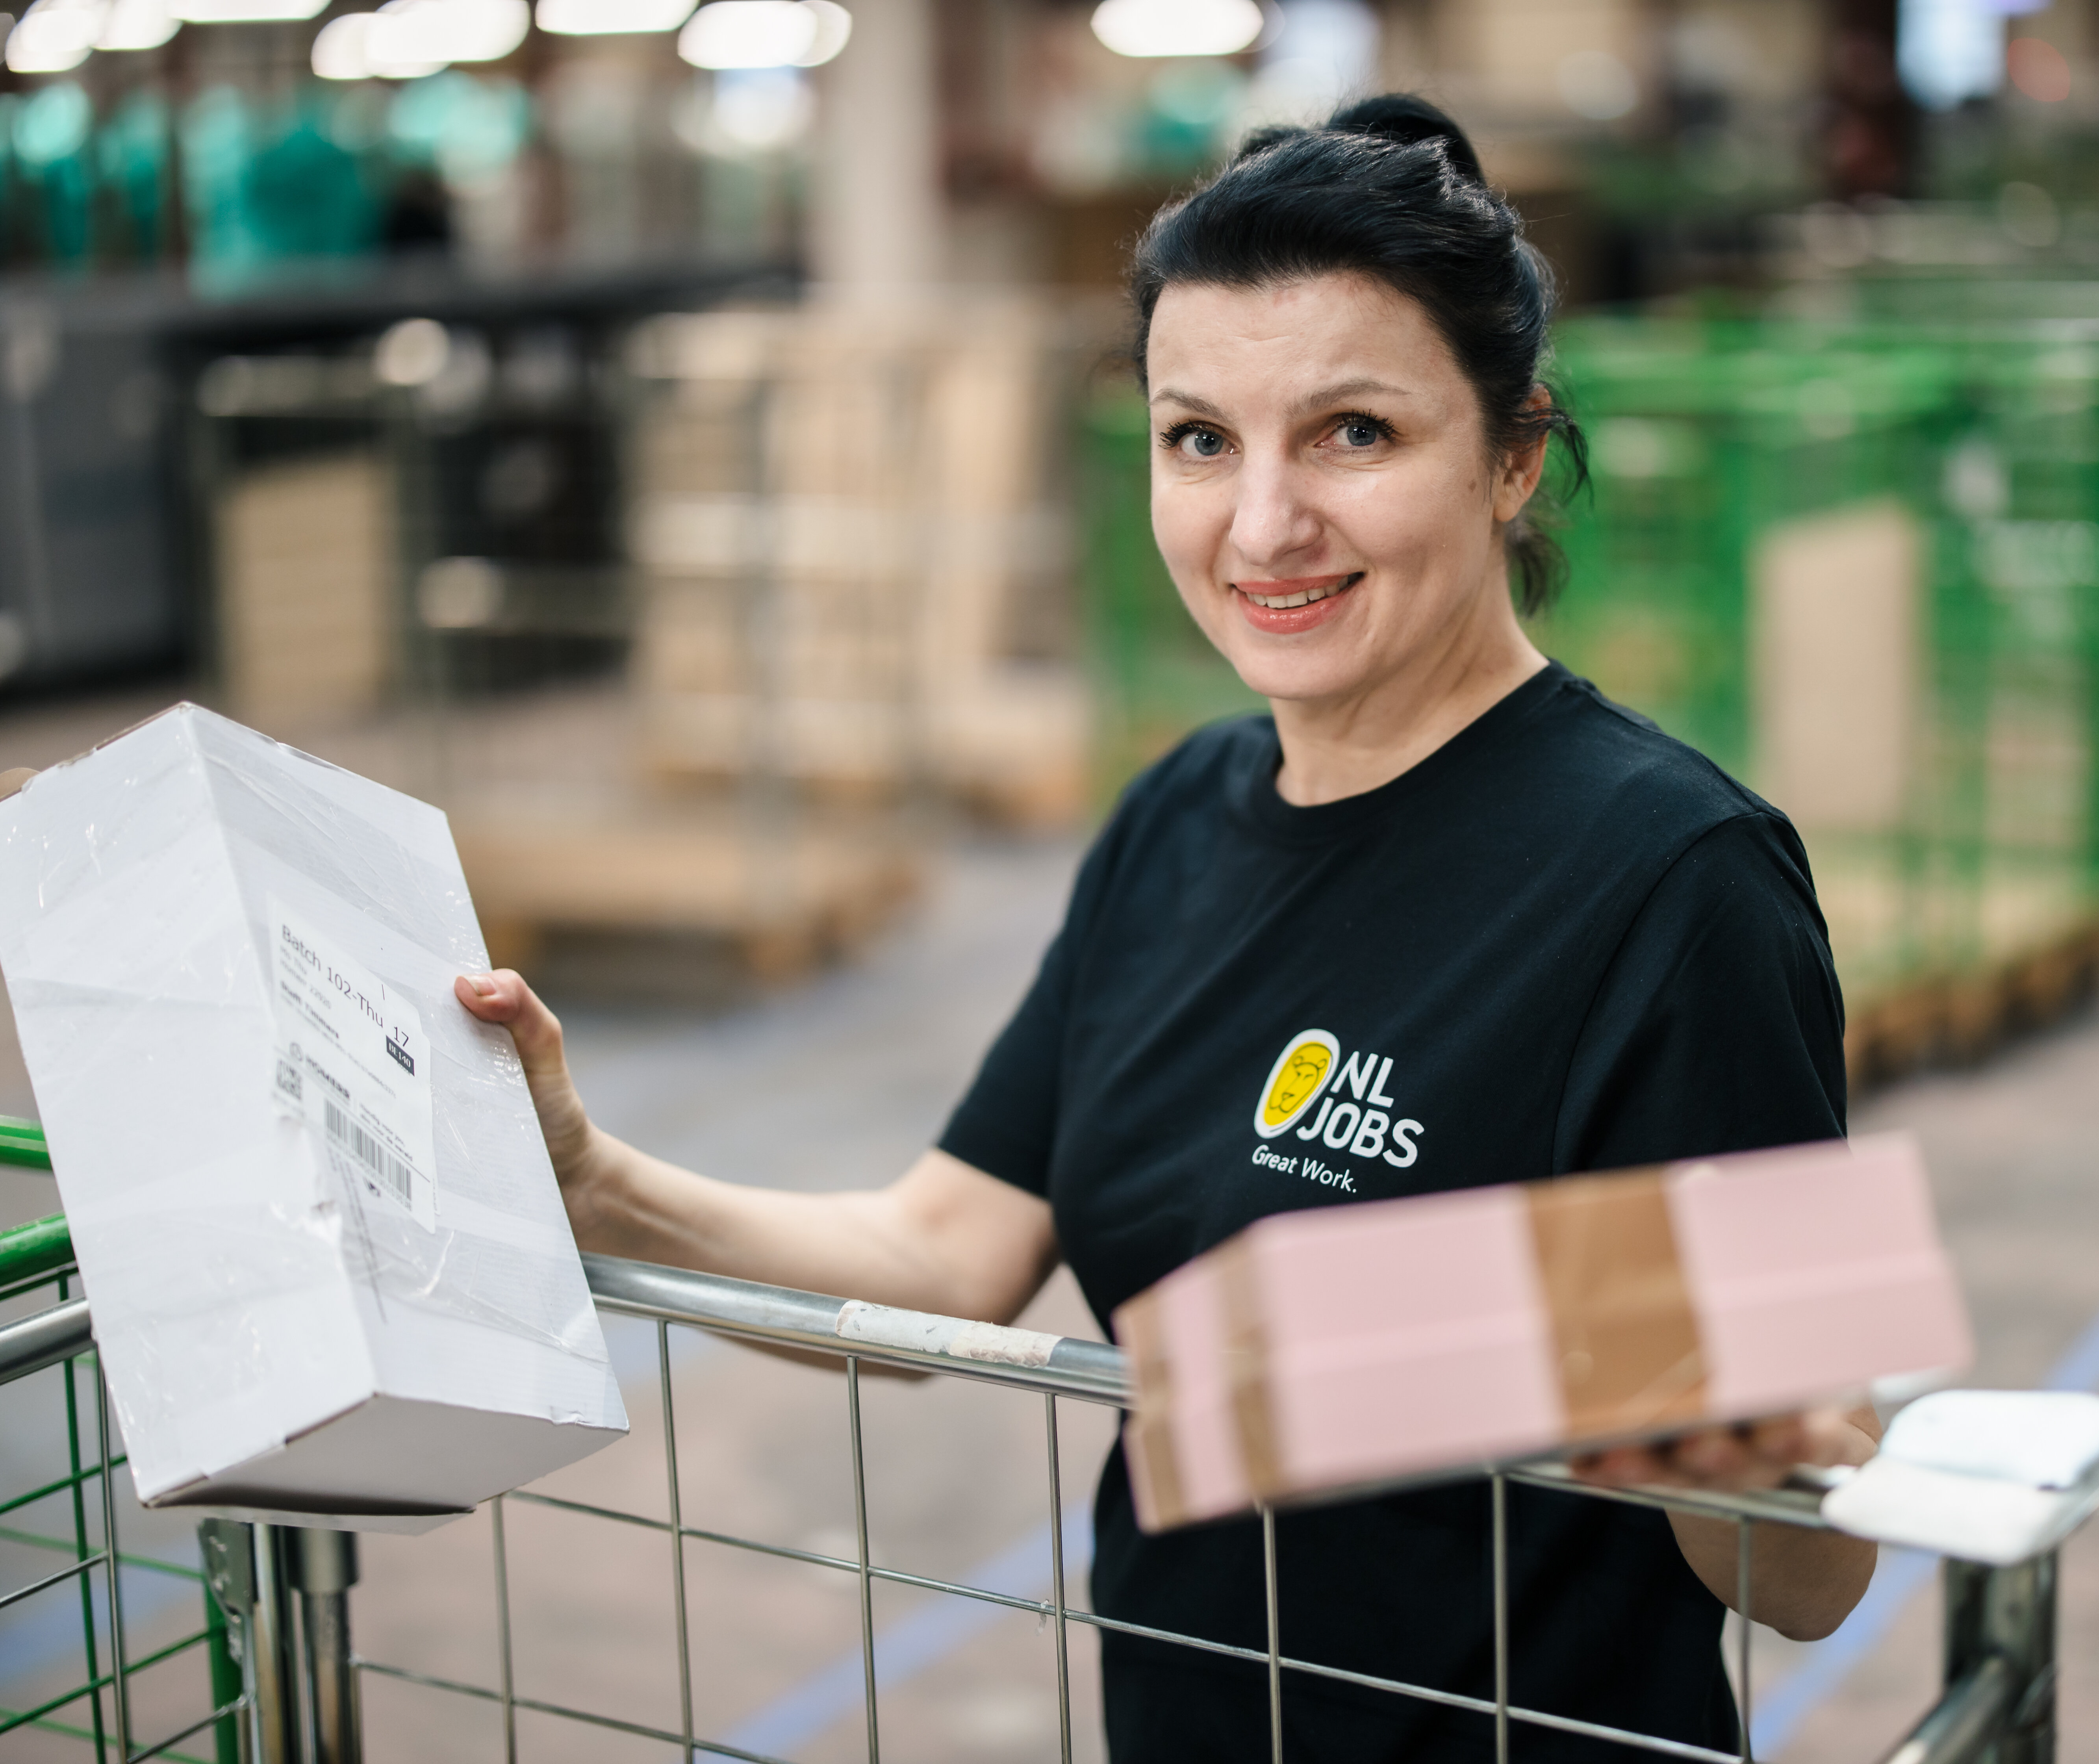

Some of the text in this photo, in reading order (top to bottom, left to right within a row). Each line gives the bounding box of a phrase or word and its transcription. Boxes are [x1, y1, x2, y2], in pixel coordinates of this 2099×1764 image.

[282, 924, 321, 971] Batch
[328, 967, 383, 1028] 102-Thu
[394, 1026, 409, 1047] 17
[388, 1042, 411, 1068] BE140
[1330, 1051, 1394, 1108] NL
[1296, 1097, 1424, 1168] JOBS
[1252, 1144, 1357, 1193] Great Work.
